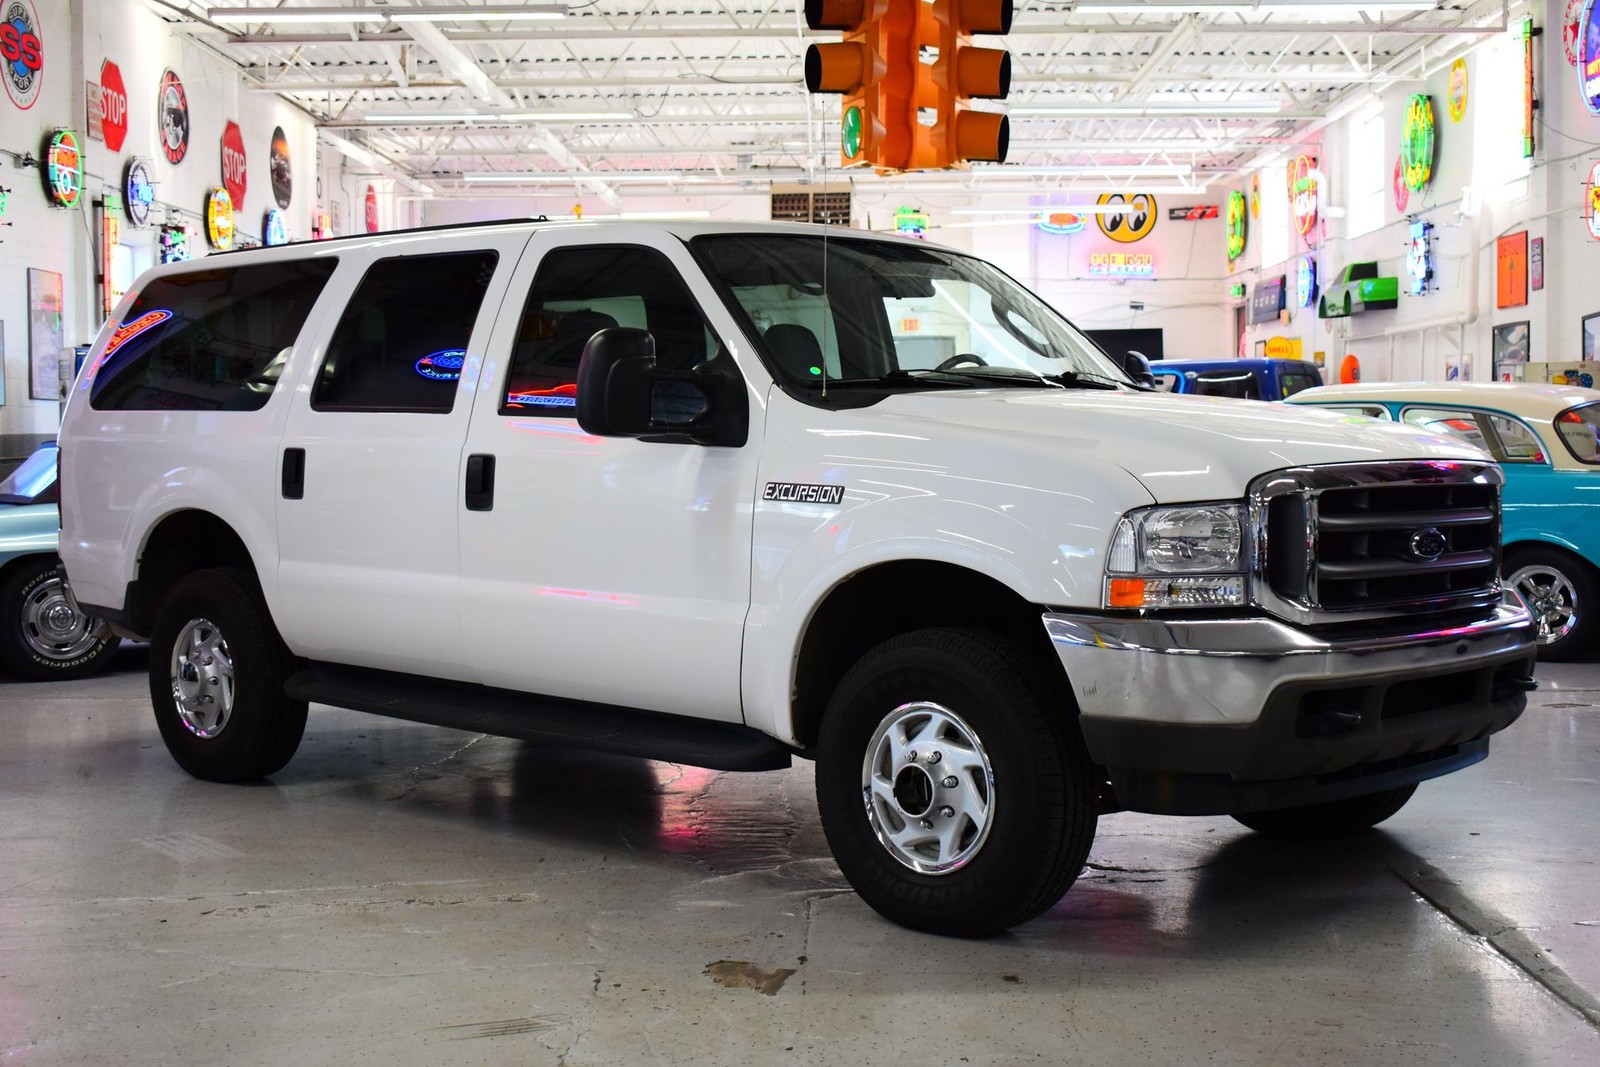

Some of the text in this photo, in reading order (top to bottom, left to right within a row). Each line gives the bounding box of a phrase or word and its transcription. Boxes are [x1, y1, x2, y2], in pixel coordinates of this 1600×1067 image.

[0, 22, 41, 71] SS
[100, 86, 126, 127] STOP
[223, 146, 246, 186] STOP
[1091, 254, 1153, 266] HEMI
[1254, 294, 1276, 308] FORD
[903, 319, 919, 331] EXIT
[763, 483, 842, 503] EXCURSION
